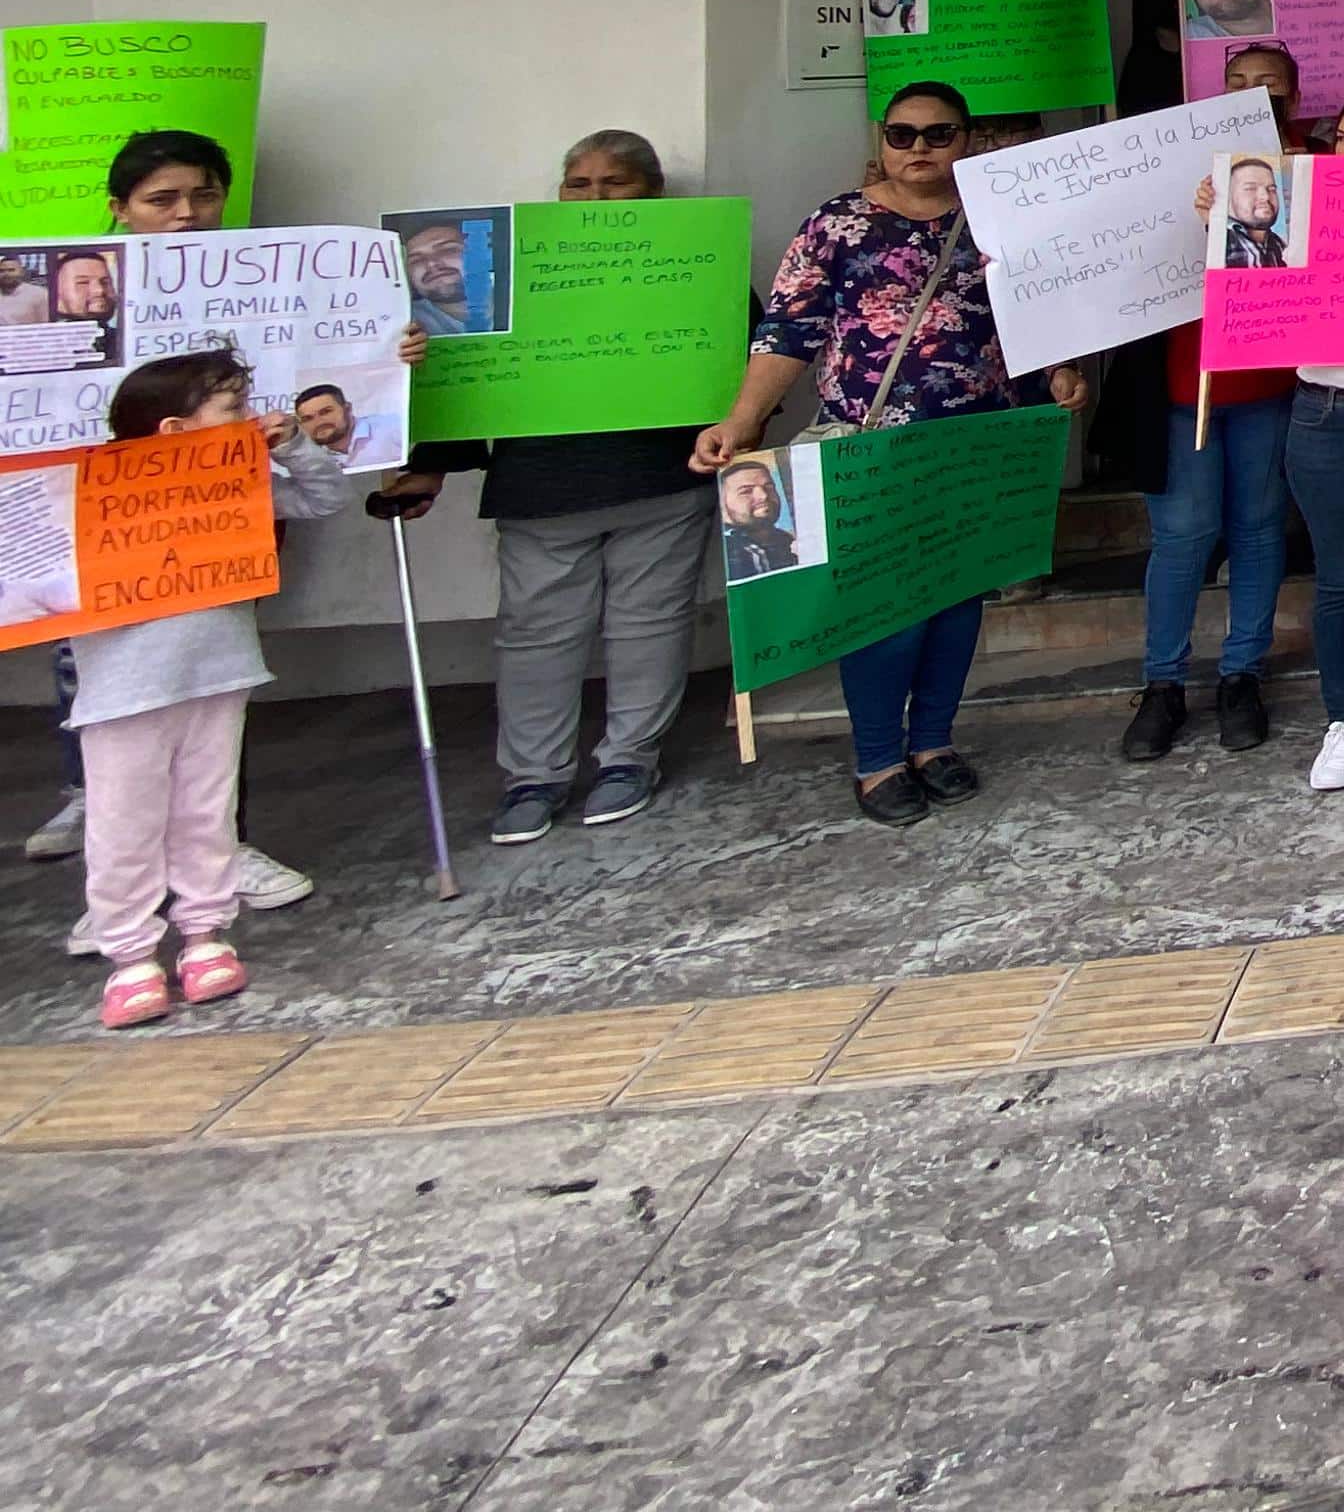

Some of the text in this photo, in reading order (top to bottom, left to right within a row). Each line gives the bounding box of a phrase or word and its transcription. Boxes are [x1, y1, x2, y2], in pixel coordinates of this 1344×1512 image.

[818, 6, 851, 24] SIN
[13, 34, 192, 61] NO BUSCO
[17, 95, 30, 110] A
[983, 106, 1272, 196] Sumate a la busqueda
[1013, 186, 1049, 209] de
[1091, 208, 1178, 247] mueve
[520, 238, 547, 256] LA
[1315, 248, 1344, 263] CON
[141, 239, 402, 294] ¡JUSTICIA!
[1143, 256, 1207, 292] Todo
[1118, 279, 1208, 318] esperamo
[1225, 276, 1251, 294] MI
[1259, 273, 1317, 290] MADRE
[205, 295, 308, 319] FAMILIA
[329, 292, 359, 310] LO
[135, 329, 239, 357] ESPERA
[263, 324, 293, 345] EN
[5, 387, 51, 423] EL
[0, 417, 105, 449] NCUENT
[81, 430, 258, 487] ¡JUSTICIA!
[161, 547, 181, 570] A
[95, 552, 278, 614] ENCONTRARLO
